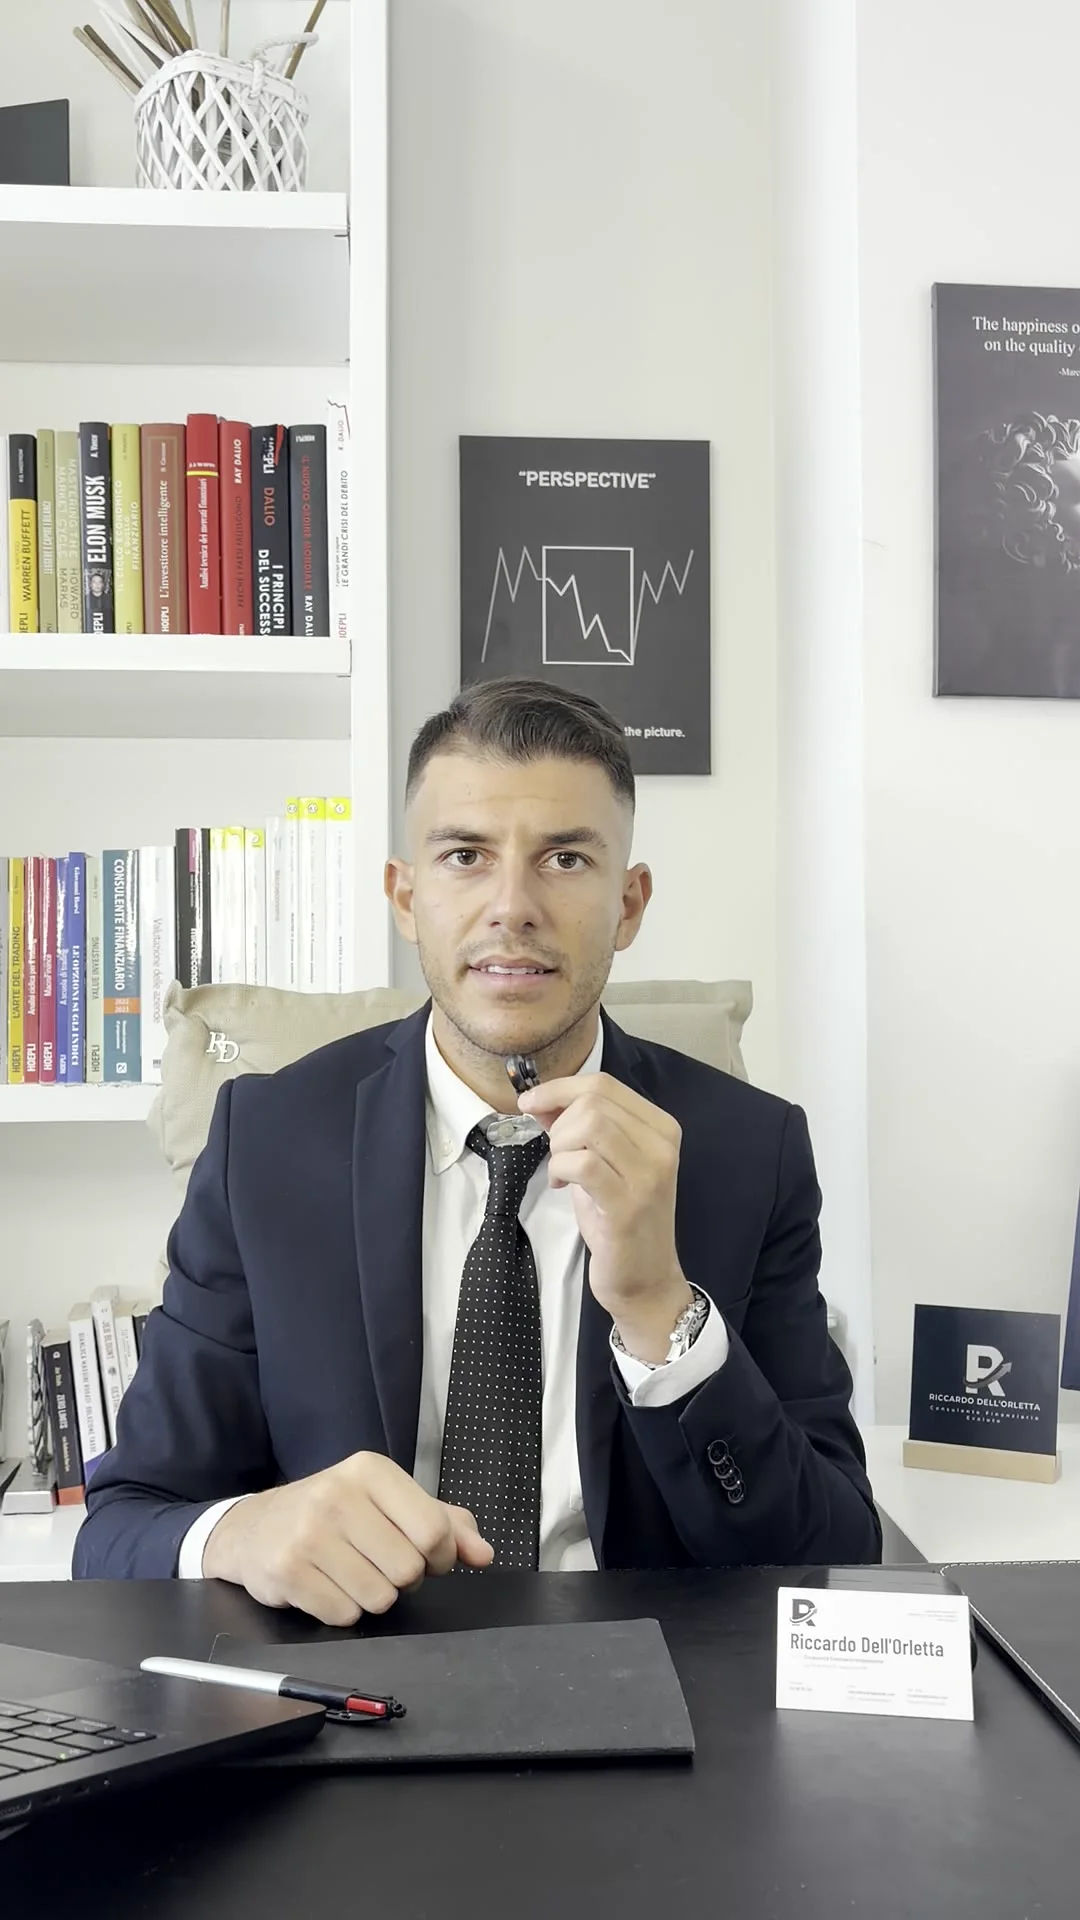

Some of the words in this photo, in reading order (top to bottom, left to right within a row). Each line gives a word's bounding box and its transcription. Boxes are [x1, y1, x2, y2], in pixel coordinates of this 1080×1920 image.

[972, 315, 999, 331] The
[1002, 316, 1068, 335] happiness
[1071, 322, 1080, 334] o
[984, 339, 1001, 351] on
[1005, 337, 1026, 352] the
[1029, 339, 1075, 357] quality
[1058, 367, 1080, 376] -Marc
[337, 420, 345, 442] DALIO
[233, 439, 242, 466] DALIO
[57, 466, 67, 514] MARKET
[233, 468, 242, 484] RAY
[302, 465, 310, 501] NUOVO
[68, 458, 78, 528] MASTERING
[85, 475, 106, 519] MUSK
[157, 480, 170, 536] intelligente
[264, 487, 275, 526] DALIO
[115, 480, 123, 543] ECONOMICO
[21, 509, 31, 553] BUFFETT
[58, 518, 67, 558] CYCLE
[69, 531, 78, 558] THE
[87, 524, 107, 563] ELON
[130, 501, 139, 570] FINANZIARIO
[341, 518, 349, 540] CRISI
[159, 538, 169, 598] L'investitore
[258, 549, 270, 573] DEL
[341, 542, 349, 577] GRANDI
[22, 557, 32, 602] WARREN
[59, 568, 68, 609] MARKS
[69, 568, 79, 619] HOWARD
[341, 578, 349, 588] LE
[259, 576, 270, 636] SUCCESS
[273, 573, 284, 629] PRINCIPI
[304, 595, 313, 612] RAY
[161, 606, 170, 633] HOEPLI
[305, 615, 314, 636] DALI
[623, 725, 642, 737] the
[643, 725, 686, 739] picture.
[114, 859, 125, 924] CONSULENTE
[12, 926, 20, 967] TRADING
[91, 936, 100, 975] INVESTING
[114, 926, 125, 990] FINANZIARIO
[152, 918, 163, 969] Valutazione
[12, 968, 20, 985] DEL
[71, 959, 80, 1001] OPZIONI
[91, 976, 99, 1000] VALUE
[152, 970, 163, 990] delle
[12, 987, 21, 1019] L'ARTE
[12, 1044, 21, 1073] HOEPLI
[27, 1043, 36, 1072] HOEPLI
[43, 1042, 53, 1071] HOEPLI
[91, 1044, 100, 1072] HOEPLI
[929, 1393, 975, 1405] RICCARDO
[977, 1398, 1040, 1411] DELL'ORLETTA
[790, 1633, 857, 1652] Riccardo
[861, 1637, 944, 1657] Dell'Orletta
